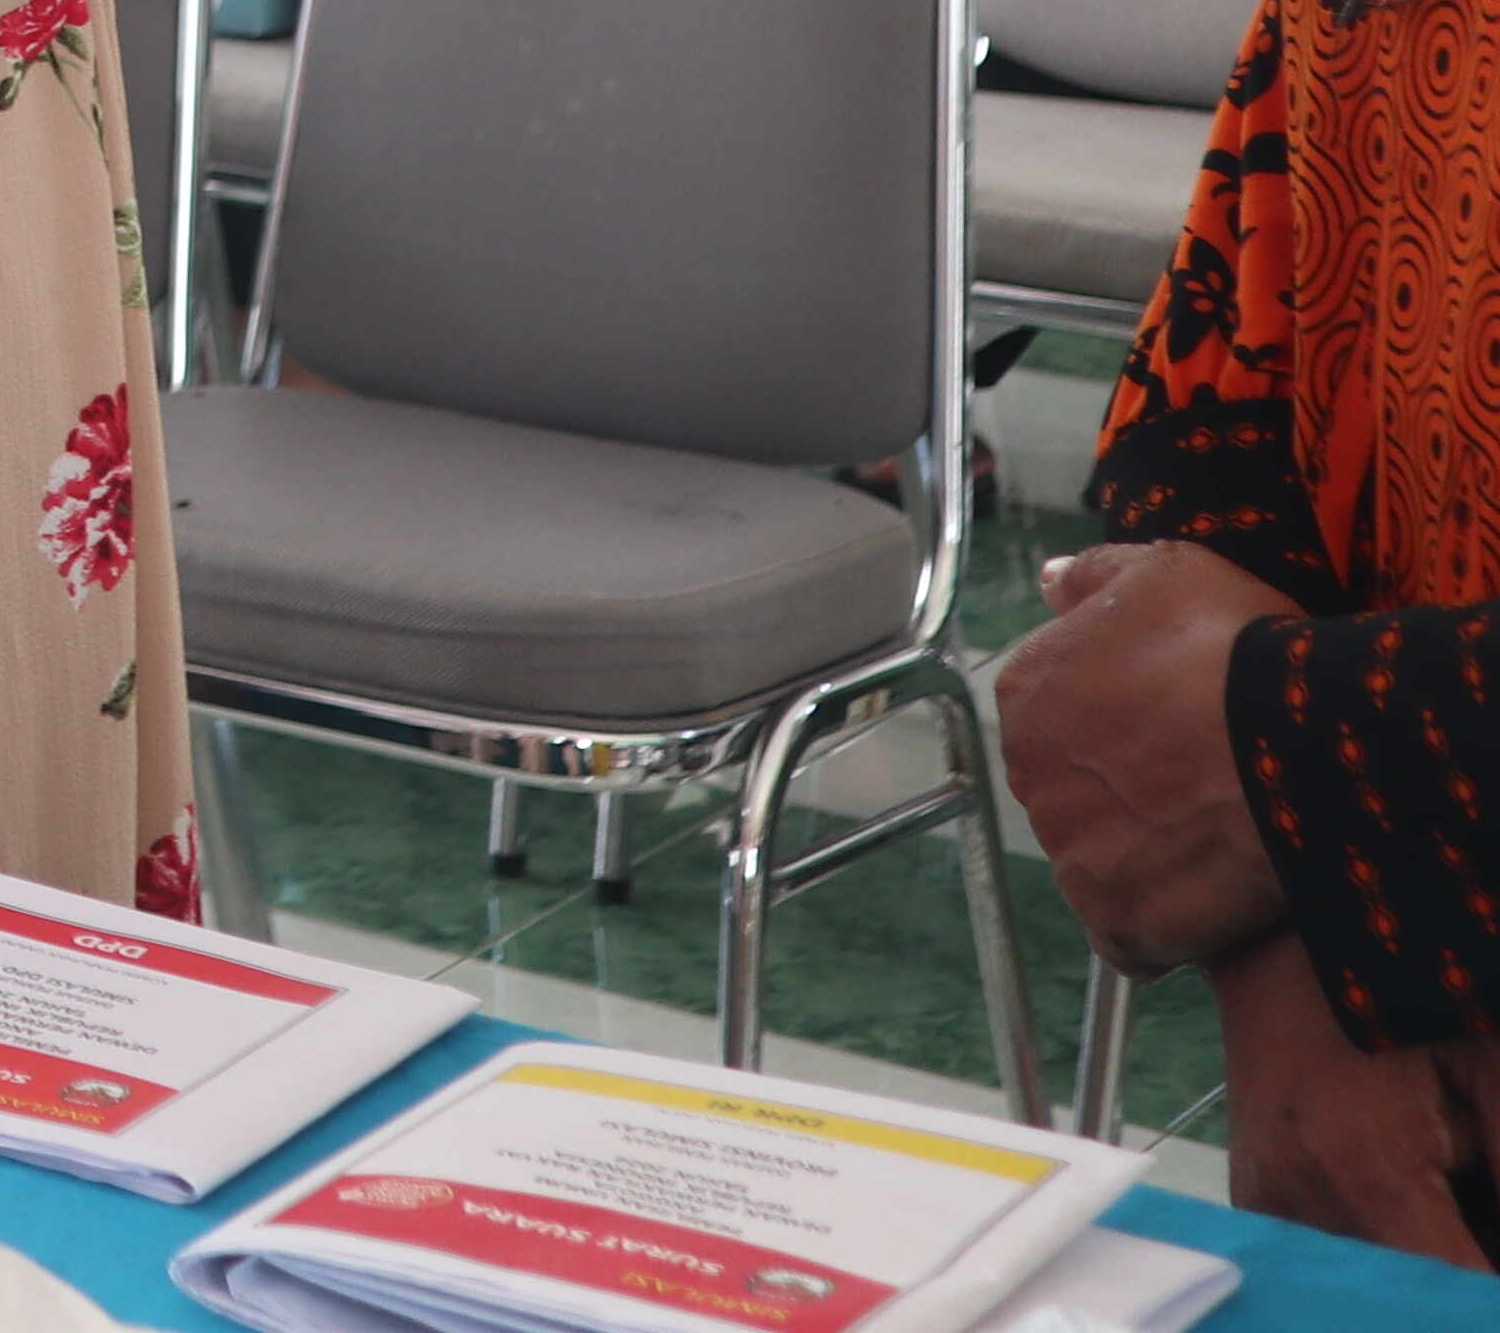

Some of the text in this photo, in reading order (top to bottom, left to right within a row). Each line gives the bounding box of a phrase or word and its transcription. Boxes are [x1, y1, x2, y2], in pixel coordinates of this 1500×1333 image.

[70, 935, 147, 960] DPD
[463, 1199, 726, 1278] SURAT SUARA
